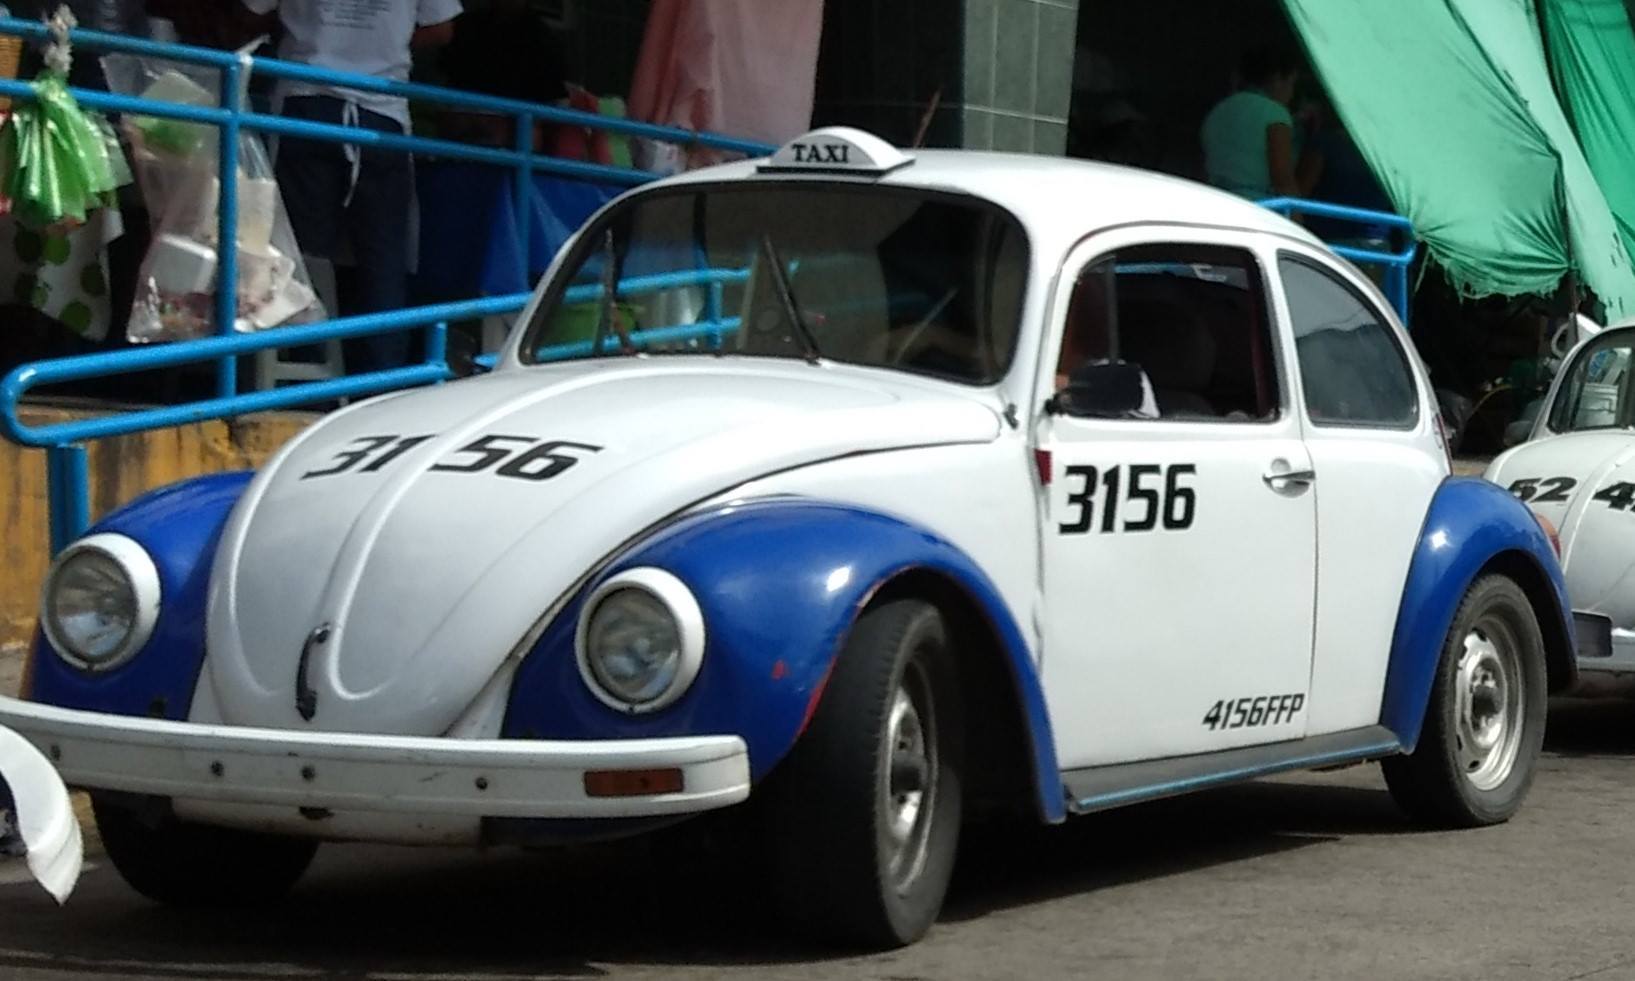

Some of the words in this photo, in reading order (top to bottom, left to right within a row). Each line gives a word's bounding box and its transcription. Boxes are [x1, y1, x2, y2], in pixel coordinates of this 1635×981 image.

[791, 143, 849, 163] TAXI
[1058, 464, 1196, 535] 3156
[1508, 477, 1577, 503] 52
[1592, 482, 1635, 512] 4
[1202, 693, 1305, 731] 4156FFP
